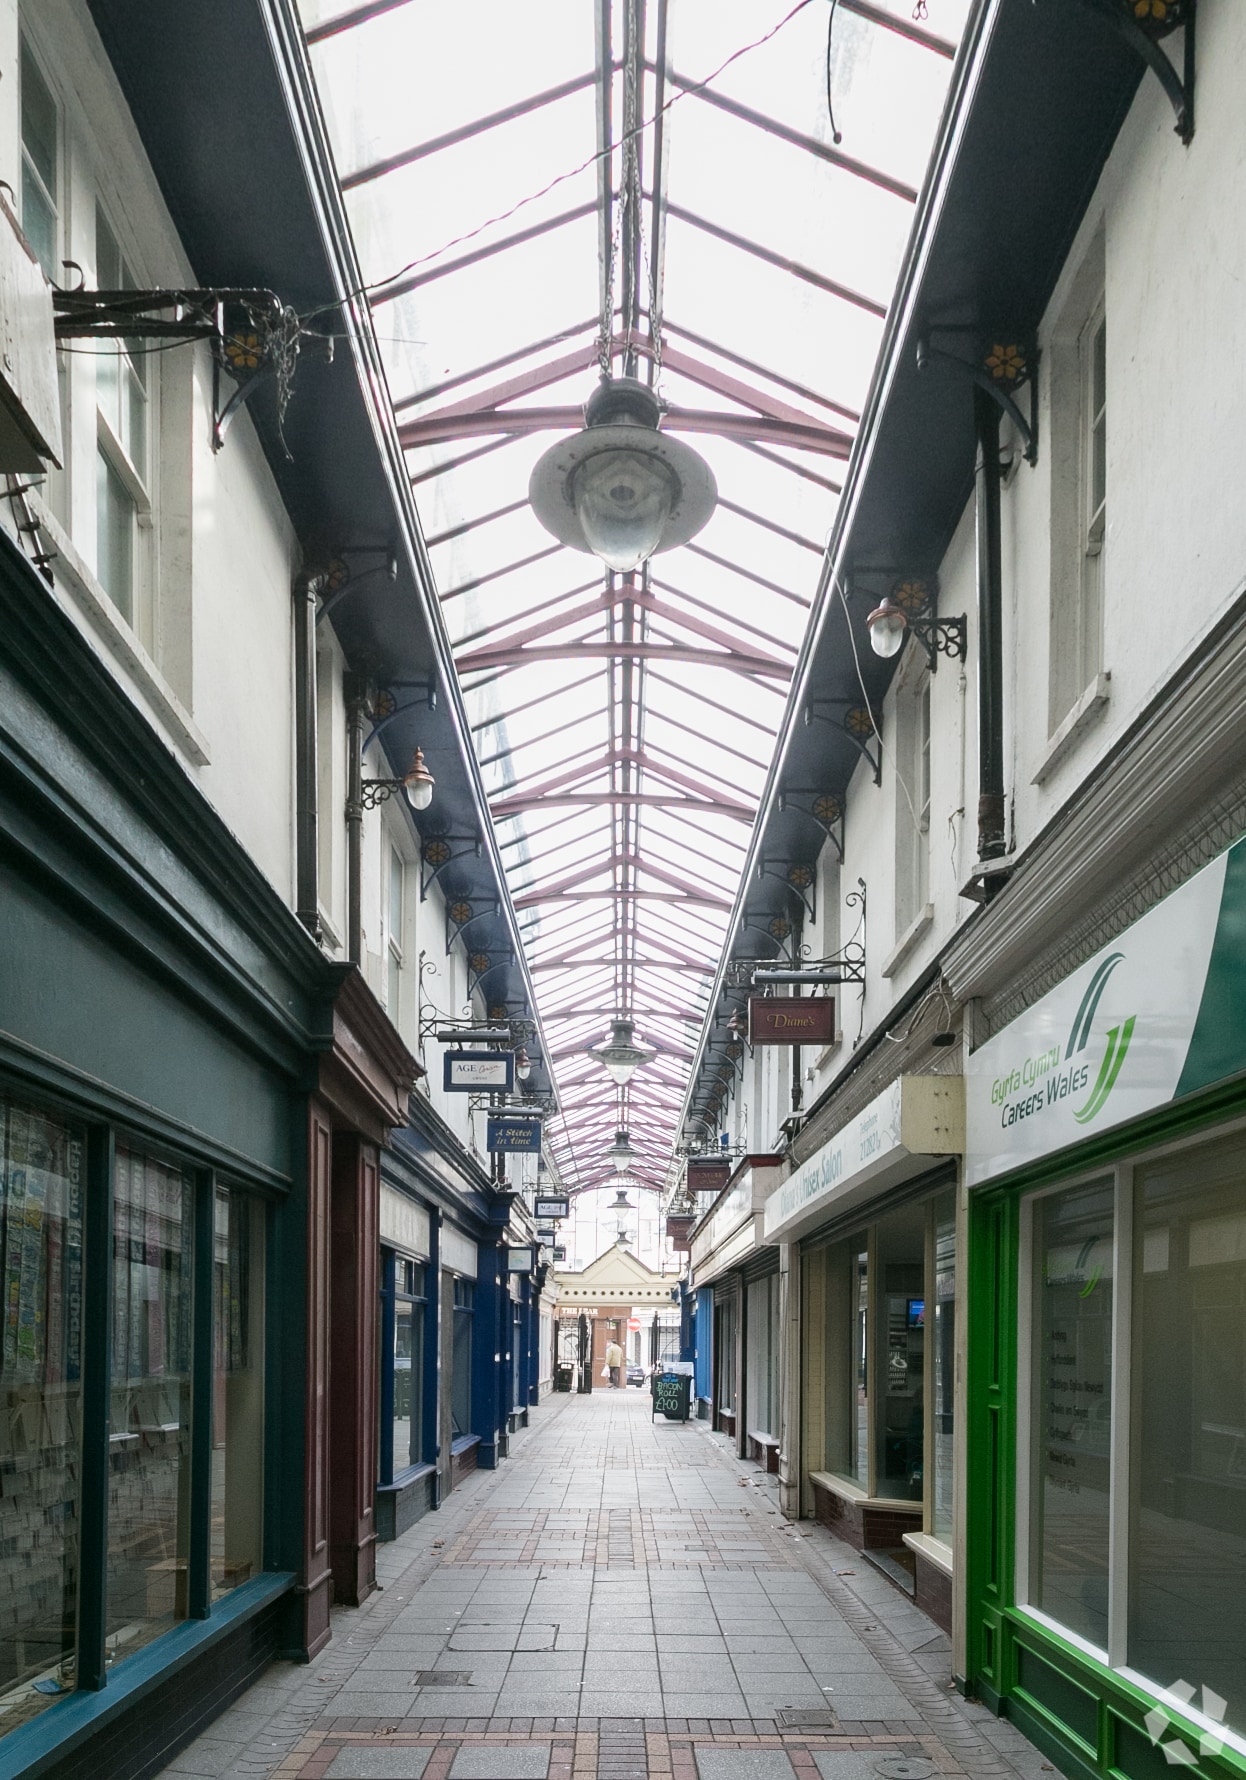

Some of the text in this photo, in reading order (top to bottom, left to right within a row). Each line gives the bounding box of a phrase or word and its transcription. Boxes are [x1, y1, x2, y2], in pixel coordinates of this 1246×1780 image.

[766, 1014, 816, 1029] Diane's
[455, 1064, 477, 1073] AGE
[991, 1044, 1061, 1107] Gyrfa Cymru
[1001, 1064, 1089, 1129] Careers Wales
[506, 1128, 533, 1137] Stitch
[821, 1147, 842, 1188] Salon
